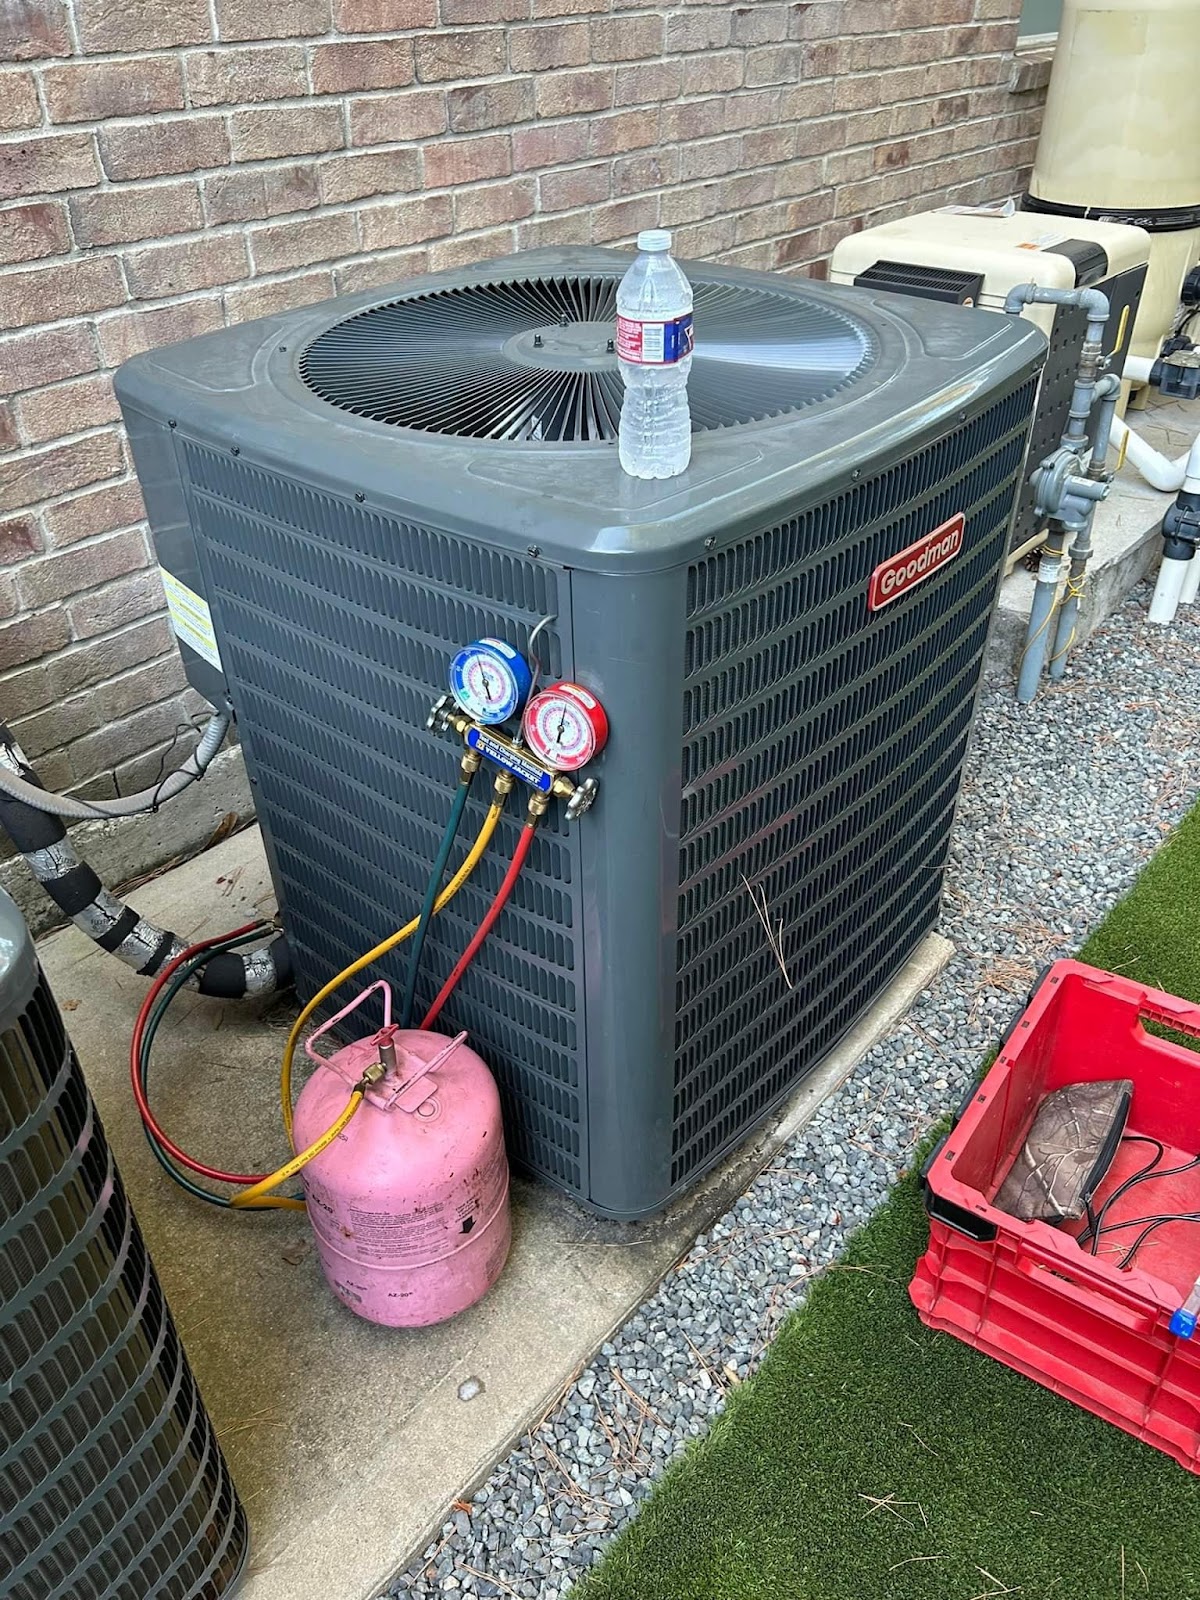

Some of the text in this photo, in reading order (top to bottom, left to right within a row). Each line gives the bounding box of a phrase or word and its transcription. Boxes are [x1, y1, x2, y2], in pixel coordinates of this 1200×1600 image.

[881, 529, 959, 595] Goodman
[485, 745, 541, 784] YELLOW JACKET
